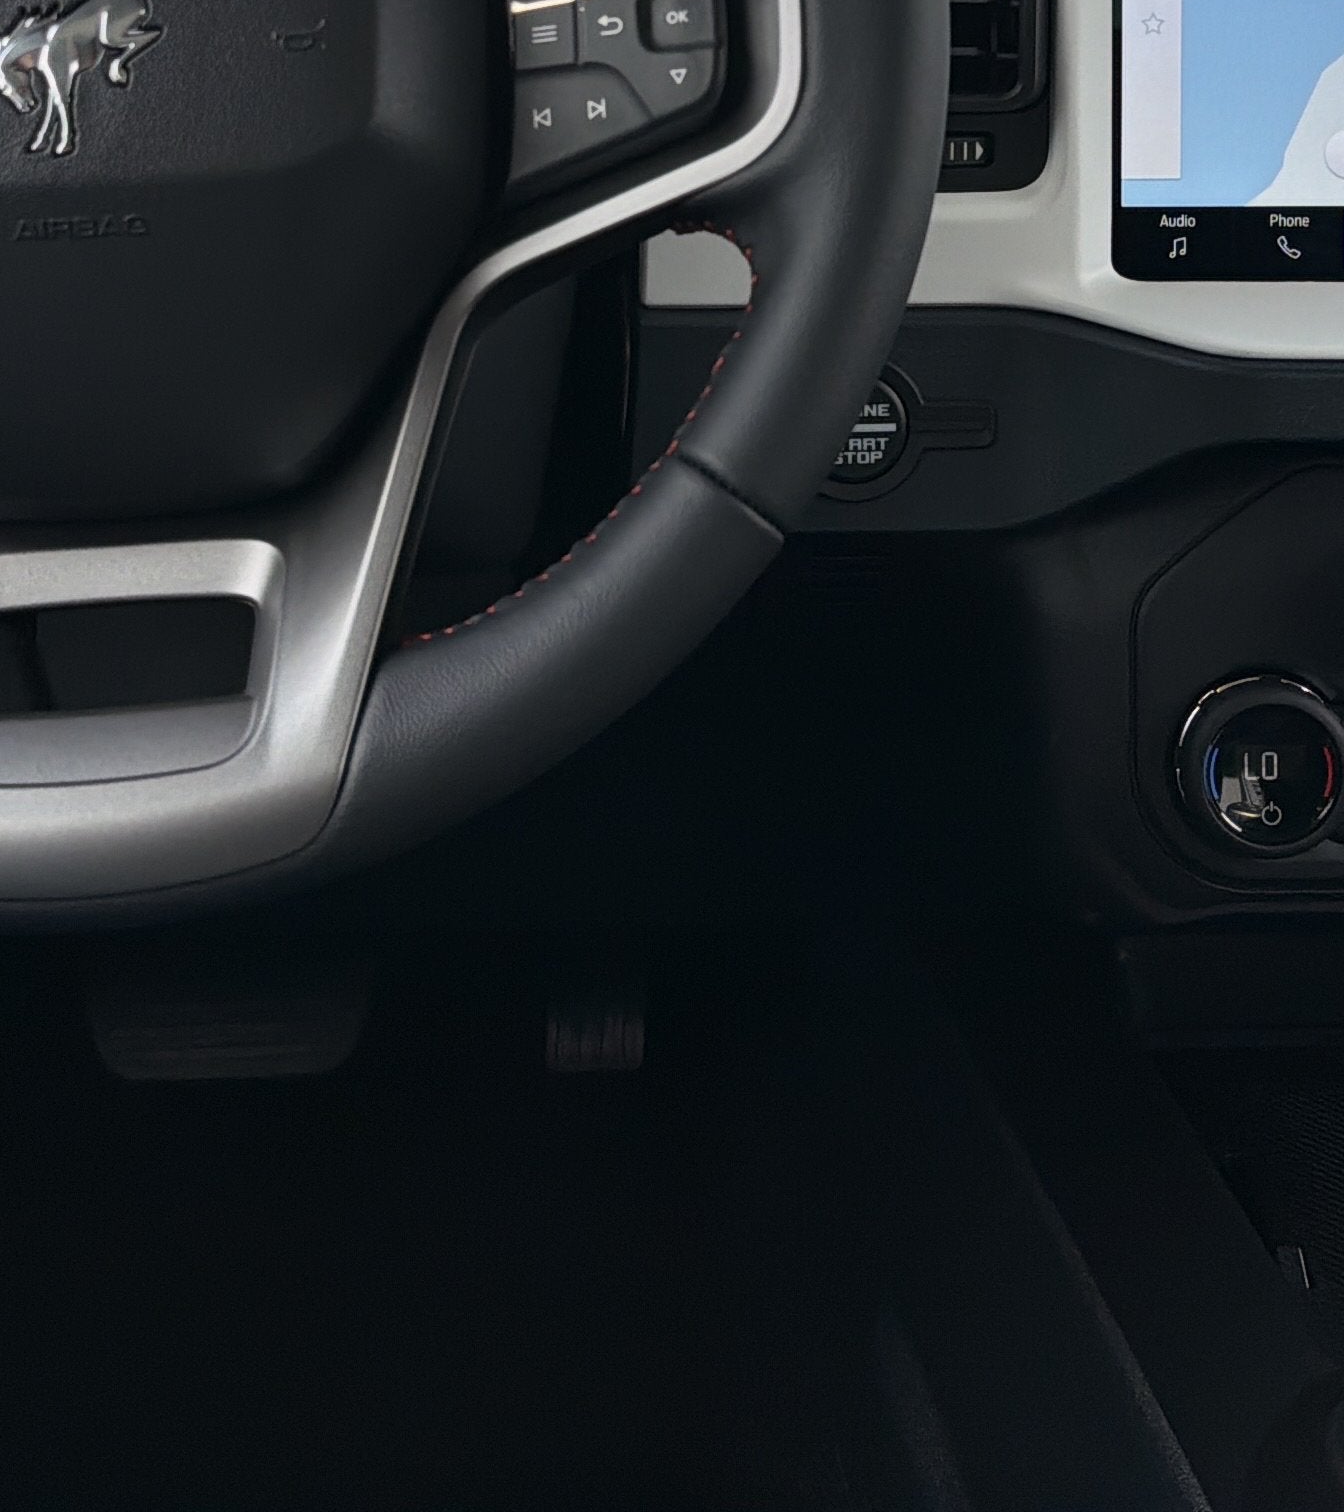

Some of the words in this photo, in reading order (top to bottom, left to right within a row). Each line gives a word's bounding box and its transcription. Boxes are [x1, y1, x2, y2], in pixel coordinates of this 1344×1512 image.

[665, 9, 690, 25] OK
[1159, 213, 1197, 229] Audio
[1268, 213, 1311, 229] Phone
[842, 437, 890, 451] ART
[1243, 751, 1278, 781] LO
